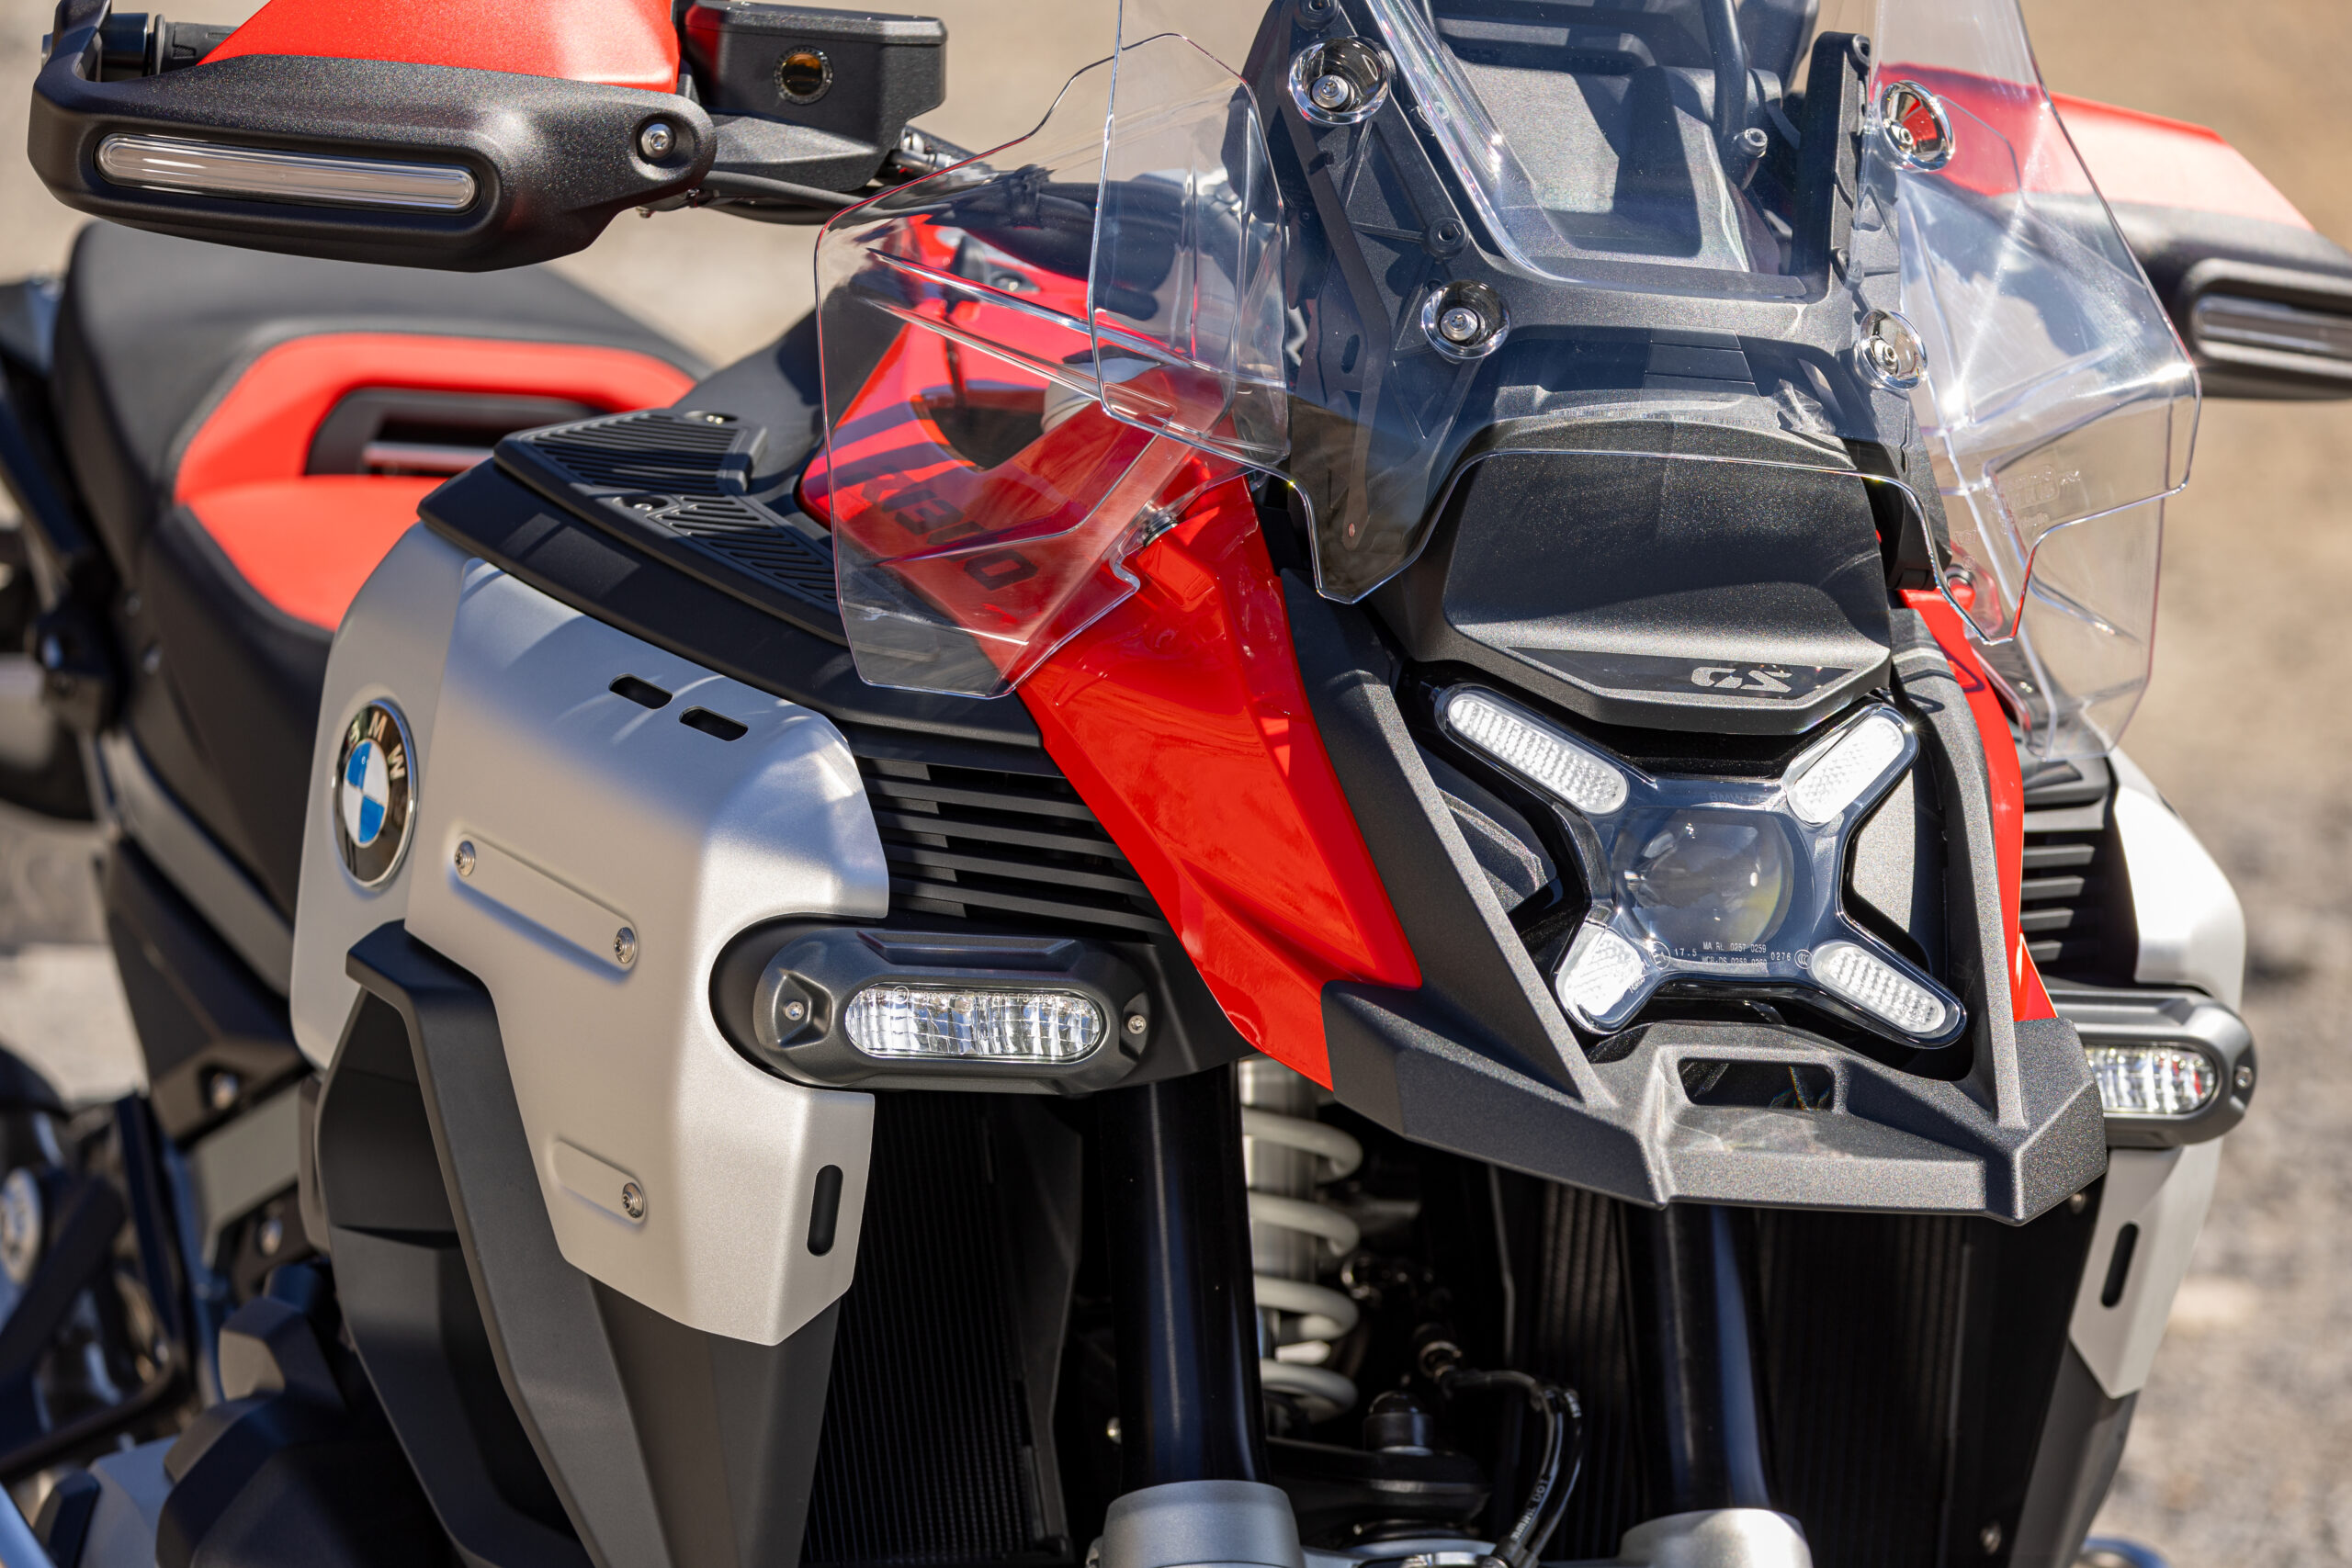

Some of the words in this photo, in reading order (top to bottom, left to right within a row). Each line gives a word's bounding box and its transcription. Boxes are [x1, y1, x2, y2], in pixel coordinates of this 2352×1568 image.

[1690, 666, 1792, 694] GS
[347, 710, 407, 781] BMW
[1674, 948, 1697, 957] 17.5
[1730, 942, 1746, 952] 0257
[1750, 943, 1767, 953] 0259
[1770, 952, 1792, 961] 0276
